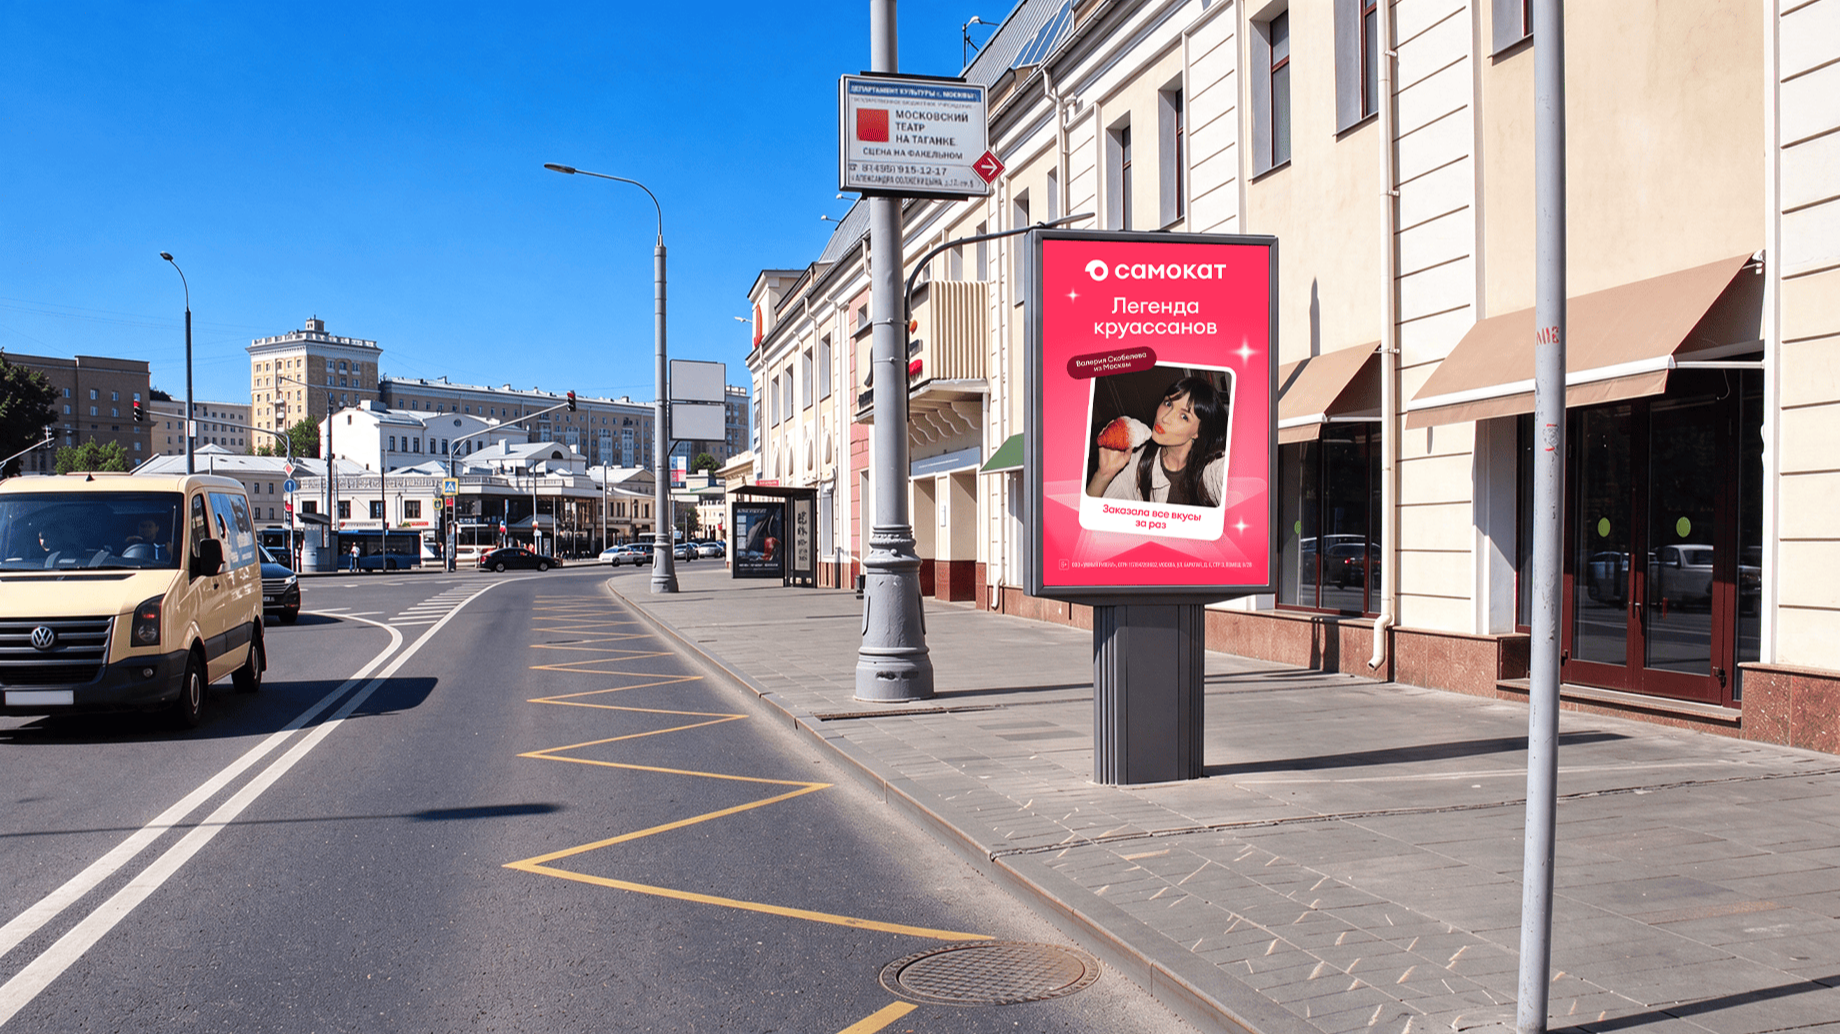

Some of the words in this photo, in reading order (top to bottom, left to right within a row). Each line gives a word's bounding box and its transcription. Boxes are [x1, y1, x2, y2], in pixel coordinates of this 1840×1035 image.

[895, 110, 969, 123] МОСКОВСКИЙ
[895, 122, 925, 131] ТЕАТР
[896, 134, 910, 144] НА
[912, 136, 956, 146] ТАГАНКЕ
[863, 147, 892, 157] СЦЕНА
[893, 148, 906, 157] НА
[907, 149, 963, 160] ФАКЕЛЬНОМ
[1114, 263, 1227, 280] самокат
[1111, 297, 1199, 317] Легенда
[1094, 321, 1218, 339] круассанов
[1076, 357, 1107, 367] Валерия
[1107, 352, 1147, 363] Скобелева
[1103, 362, 1131, 370] Москвы
[1102, 504, 1150, 517] Заказала
[1152, 509, 1170, 518] все
[1171, 511, 1202, 522] вкусы
[1135, 519, 1147, 528] за
[1148, 520, 1167, 530] раз
